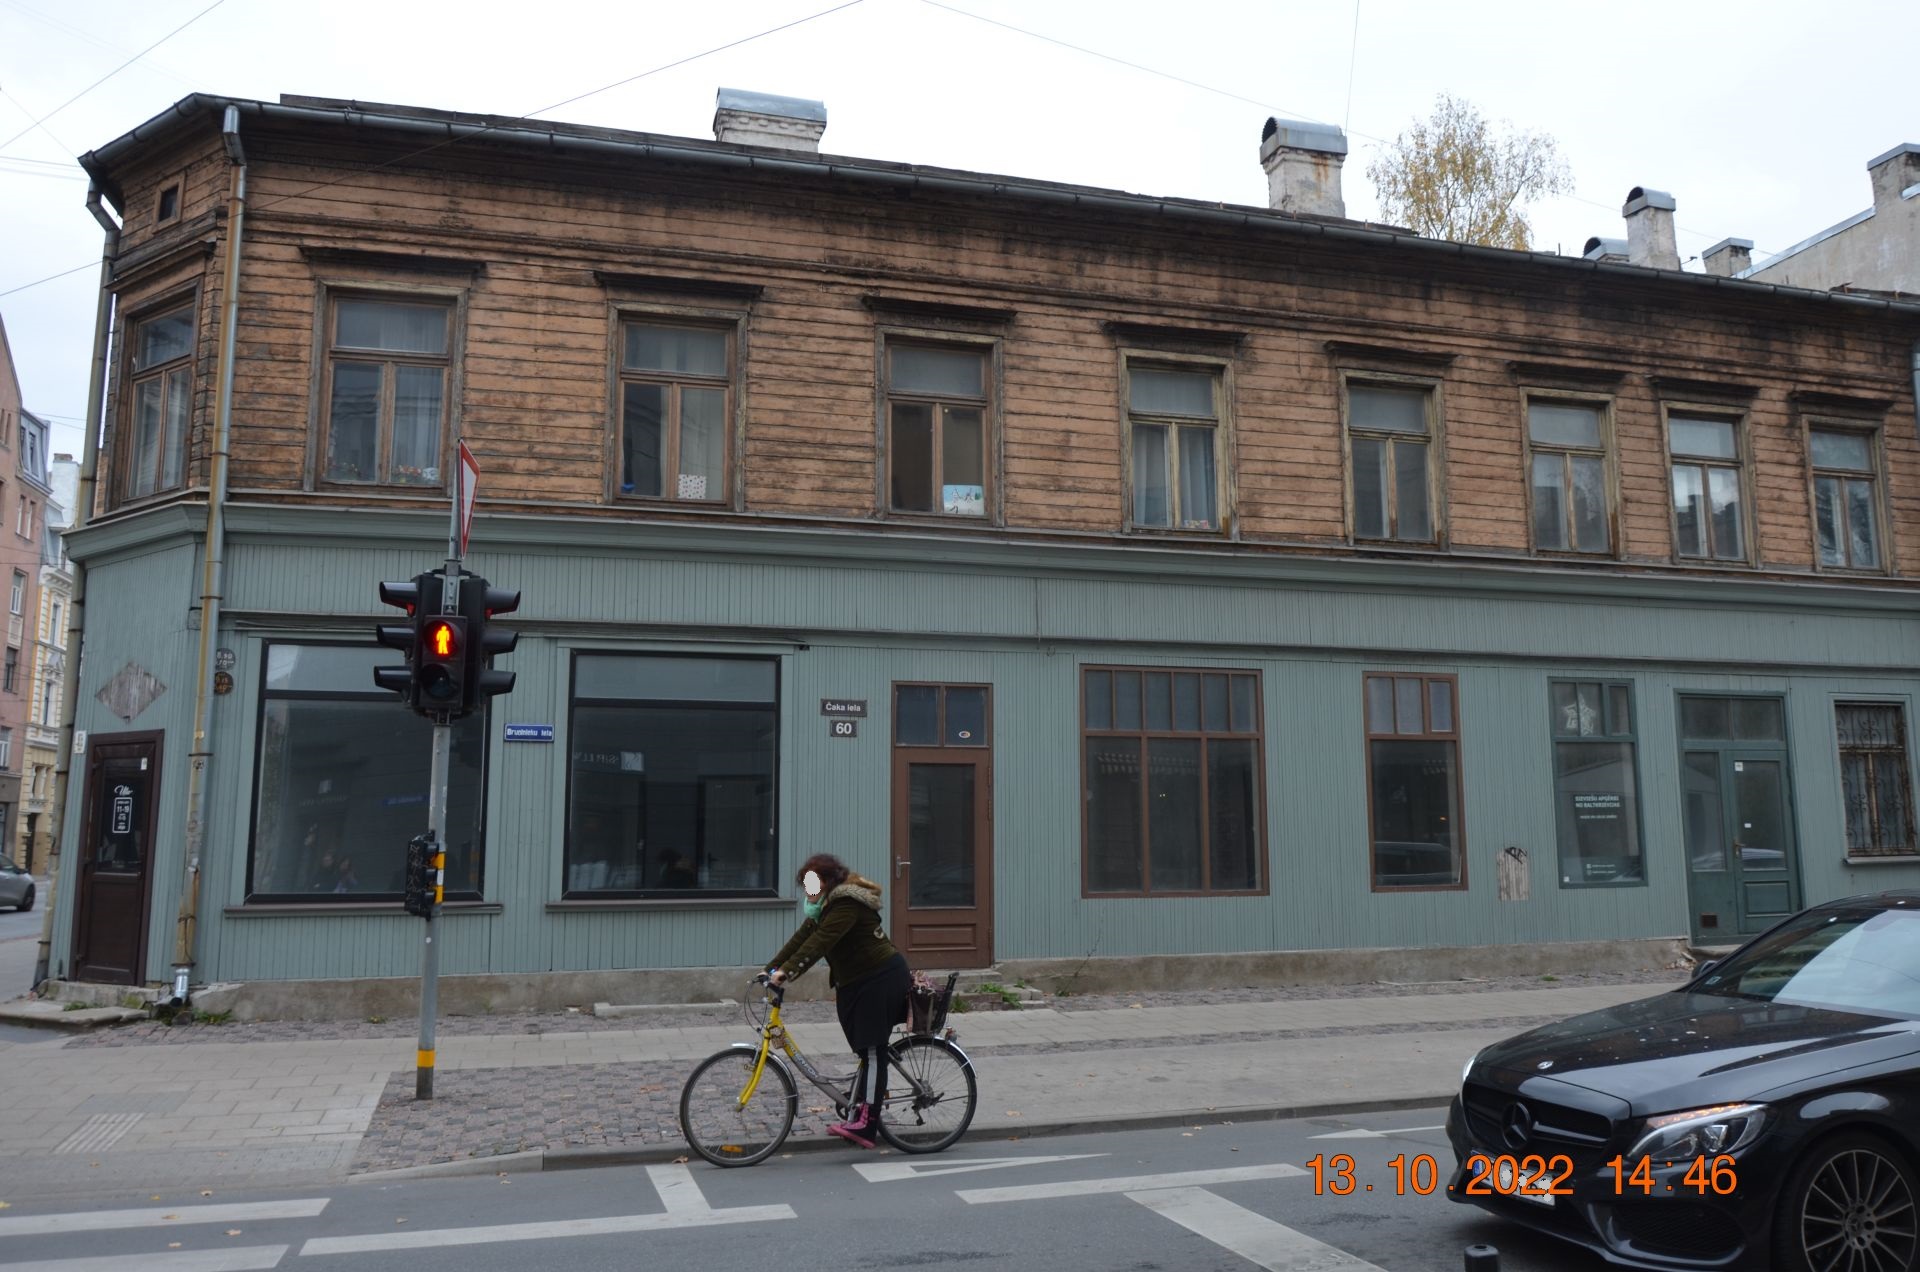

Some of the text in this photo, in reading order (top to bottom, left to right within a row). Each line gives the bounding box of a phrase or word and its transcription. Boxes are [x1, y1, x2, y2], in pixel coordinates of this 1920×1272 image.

[825, 701, 861, 712] Čaka iela
[835, 722, 852, 735] 60
